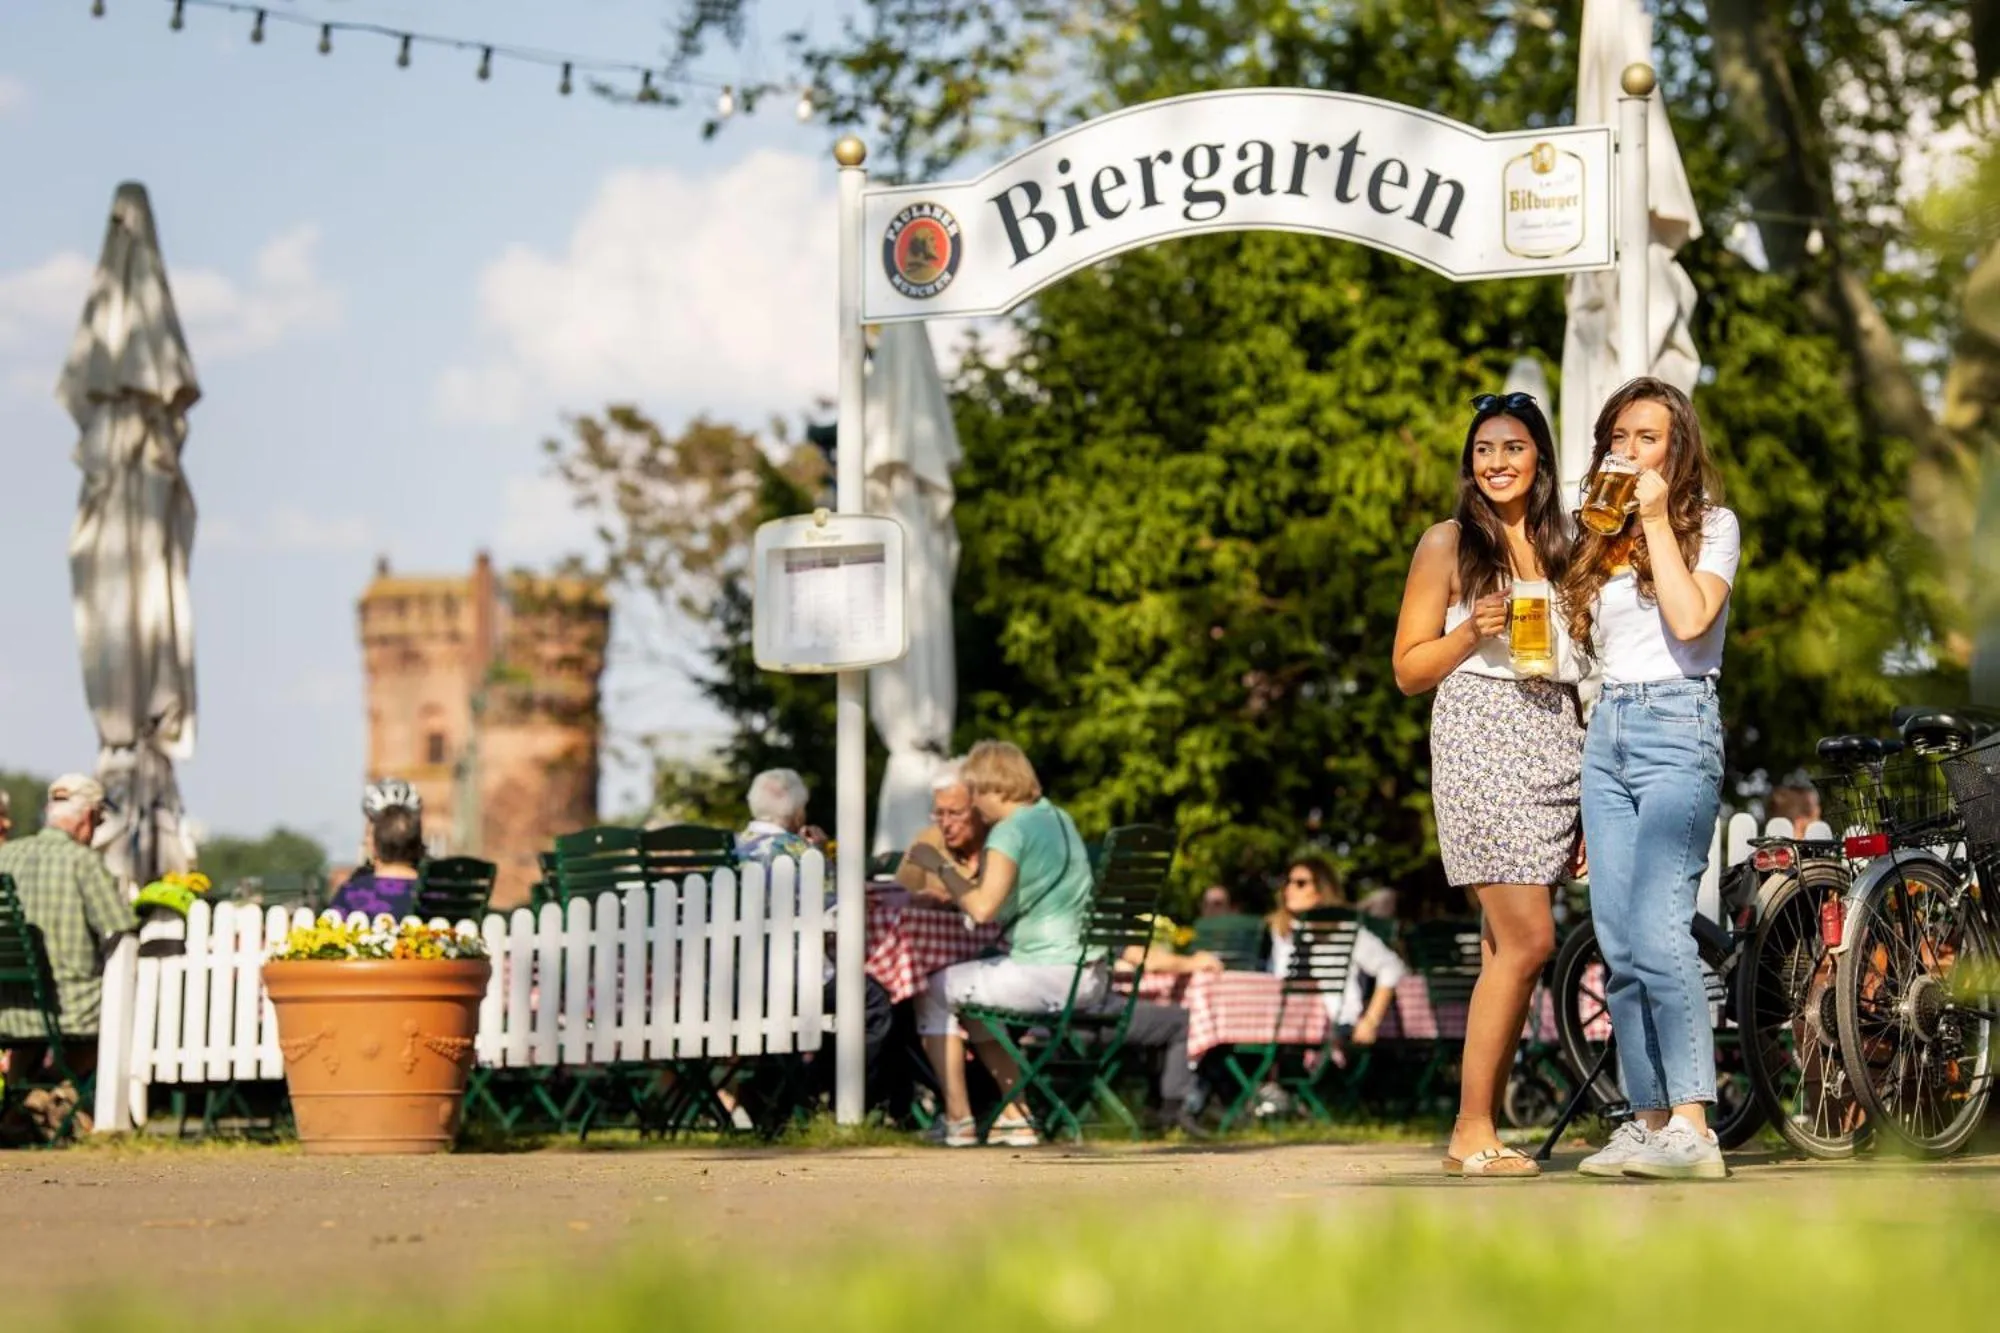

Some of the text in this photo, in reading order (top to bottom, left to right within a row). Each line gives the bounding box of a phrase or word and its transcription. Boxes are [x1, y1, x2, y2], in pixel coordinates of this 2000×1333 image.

[987, 129, 1465, 269] Biergarten
[1509, 190, 1579, 212] Bitburger
[886, 203, 959, 241] PAULANER
